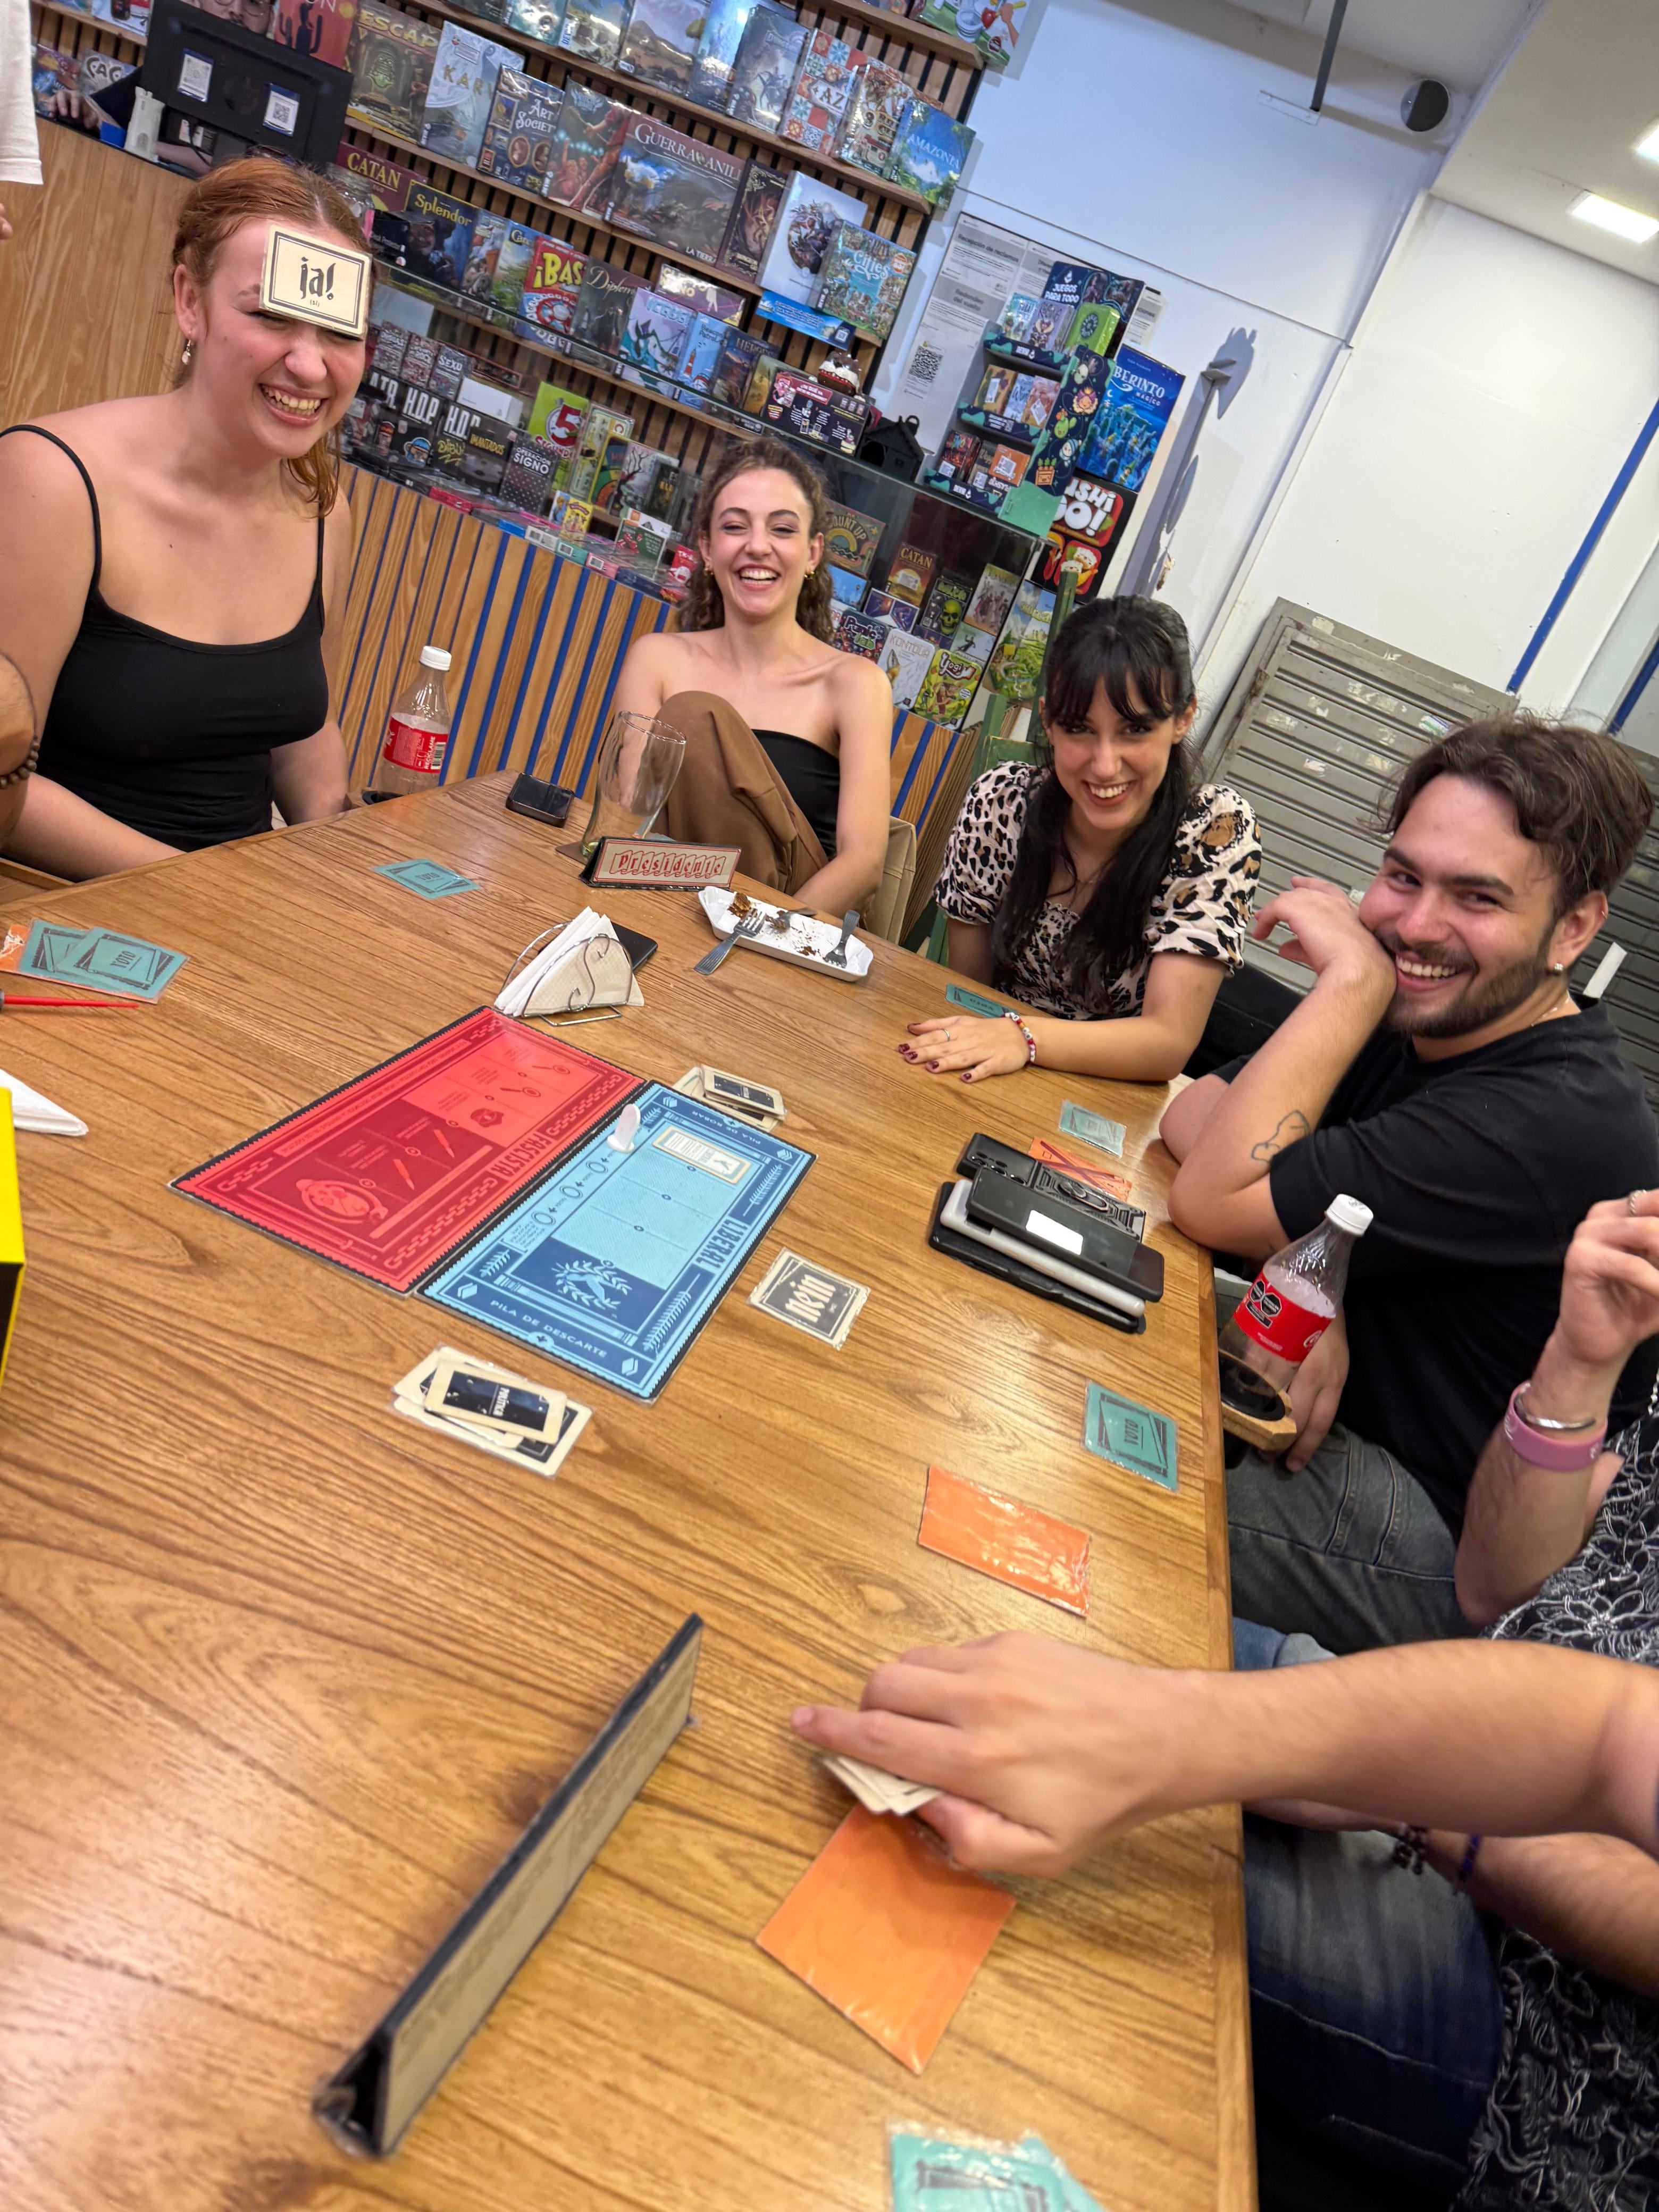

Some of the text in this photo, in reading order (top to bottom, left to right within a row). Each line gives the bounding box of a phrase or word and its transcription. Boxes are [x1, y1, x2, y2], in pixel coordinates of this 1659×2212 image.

[515, 111, 556, 133] SOCIET
[529, 99, 554, 121] ART
[634, 123, 695, 162] GUERRA
[907, 133, 959, 169] AMAZONIA
[347, 152, 401, 189] CATAN
[414, 193, 472, 227] Splendor
[685, 246, 695, 256] LA
[299, 256, 336, 300] ja!
[853, 250, 890, 281] Cities
[1044, 291, 1080, 303] PARA TODO
[550, 404, 582, 447] 5
[513, 452, 550, 475] SIGNO
[832, 514, 868, 541] OUNT UP
[900, 547, 933, 569] CATAN
[889, 635, 930, 659] KONTOUR
[939, 652, 963, 676] Yogi
[617, 852, 722, 876] Presidente
[110, 950, 137, 968] VOTO
[692, 1110, 723, 1127] ROBAR
[742, 1133, 761, 1145] PILA
[495, 1132, 552, 1178] FASCISTA
[698, 1218, 748, 1268] LIBERAL
[784, 1273, 837, 1323] nein
[490, 1300, 609, 1358] PILA DE DESCARTE
